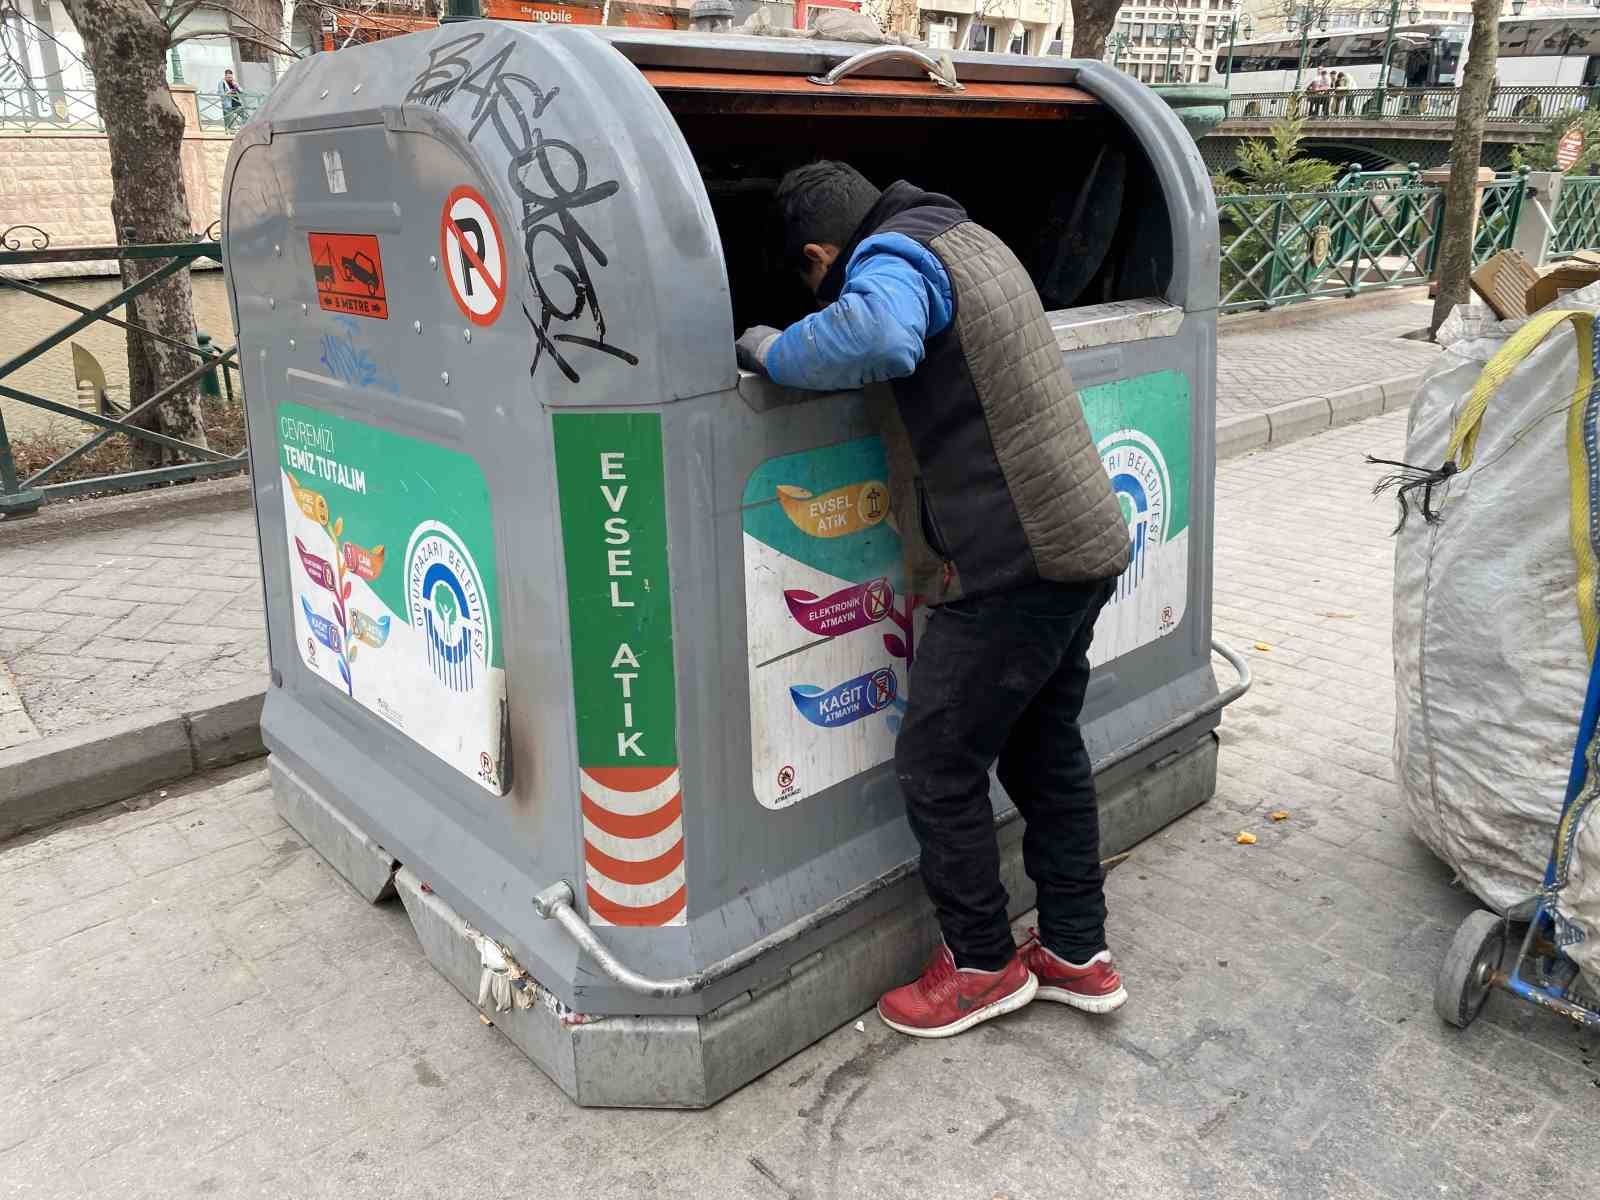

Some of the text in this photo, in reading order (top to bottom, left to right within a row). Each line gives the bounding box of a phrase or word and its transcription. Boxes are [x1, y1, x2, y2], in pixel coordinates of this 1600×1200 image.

[532, 9, 573, 22] mobile
[342, 299, 370, 312] METRE
[283, 444, 367, 495] TEMİZ TUTALIM
[809, 494, 854, 519] EVSEL
[600, 452, 646, 757] EVSEL ATIK
[820, 611, 856, 630] ATMAYIN
[819, 685, 864, 716] KAĞIT
[825, 703, 860, 724] ATMAYIN
